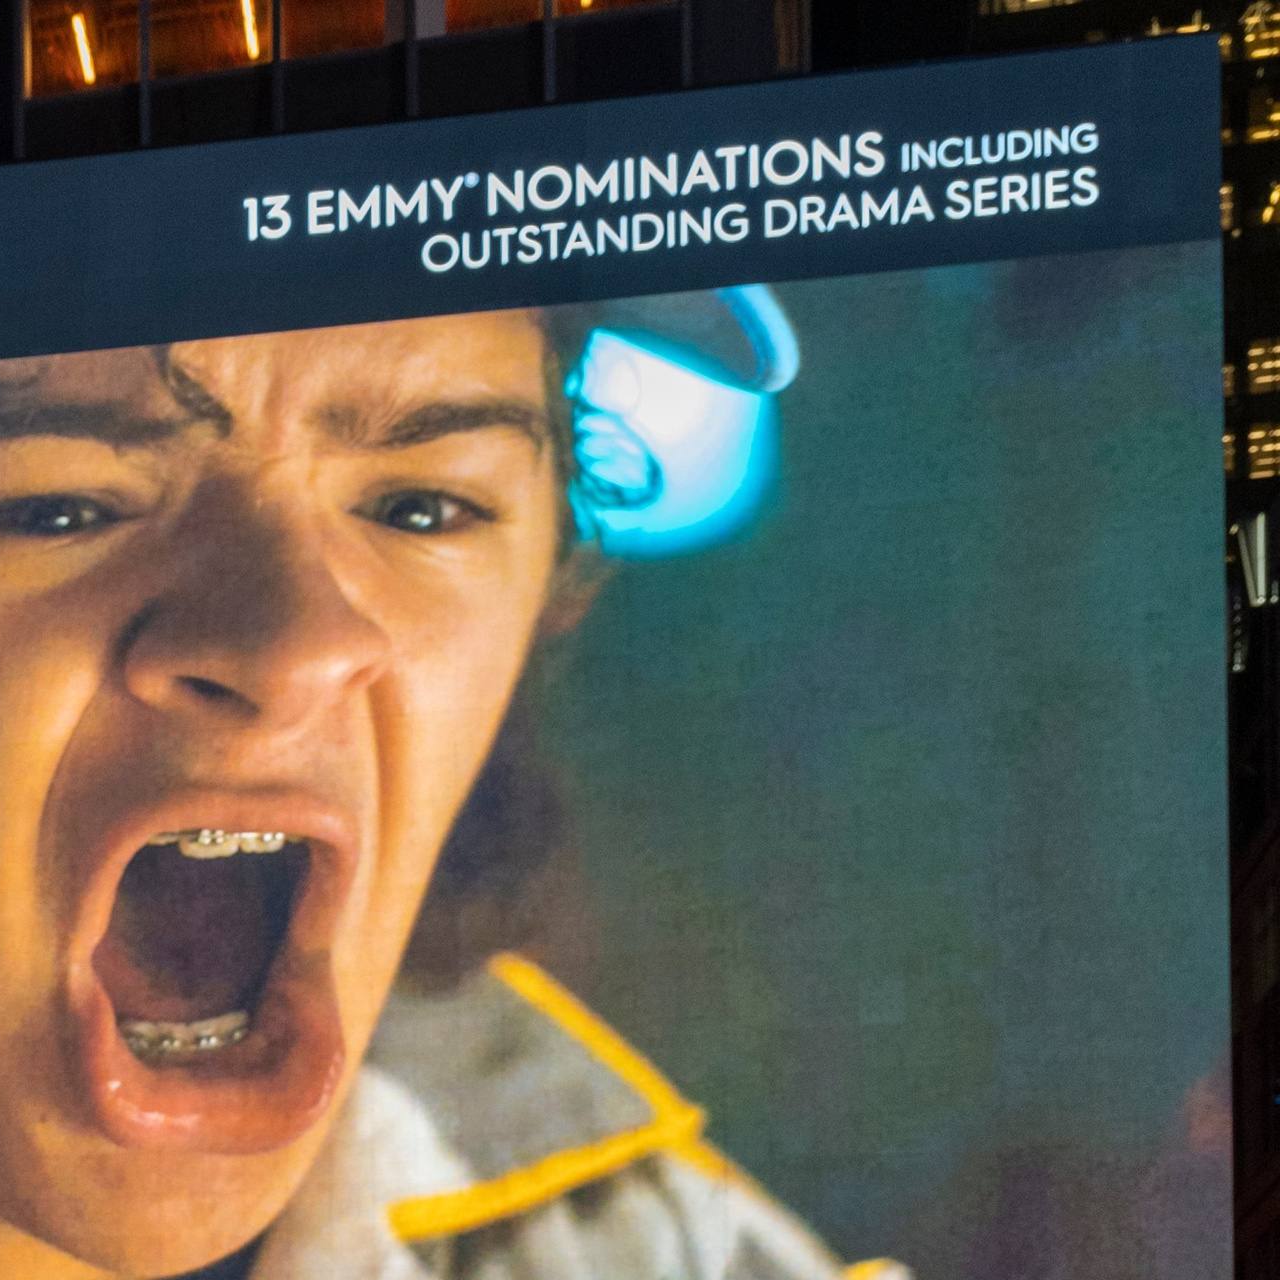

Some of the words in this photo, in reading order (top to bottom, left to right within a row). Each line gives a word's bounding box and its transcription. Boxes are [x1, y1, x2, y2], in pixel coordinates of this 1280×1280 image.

[243, 194, 292, 241] 13
[487, 131, 885, 217] NOMINATIONS
[900, 121, 1099, 173] INCLUDING
[421, 203, 749, 273] OUTSTANDING
[764, 185, 935, 239] DRAMA
[943, 166, 1100, 220] SERIES
